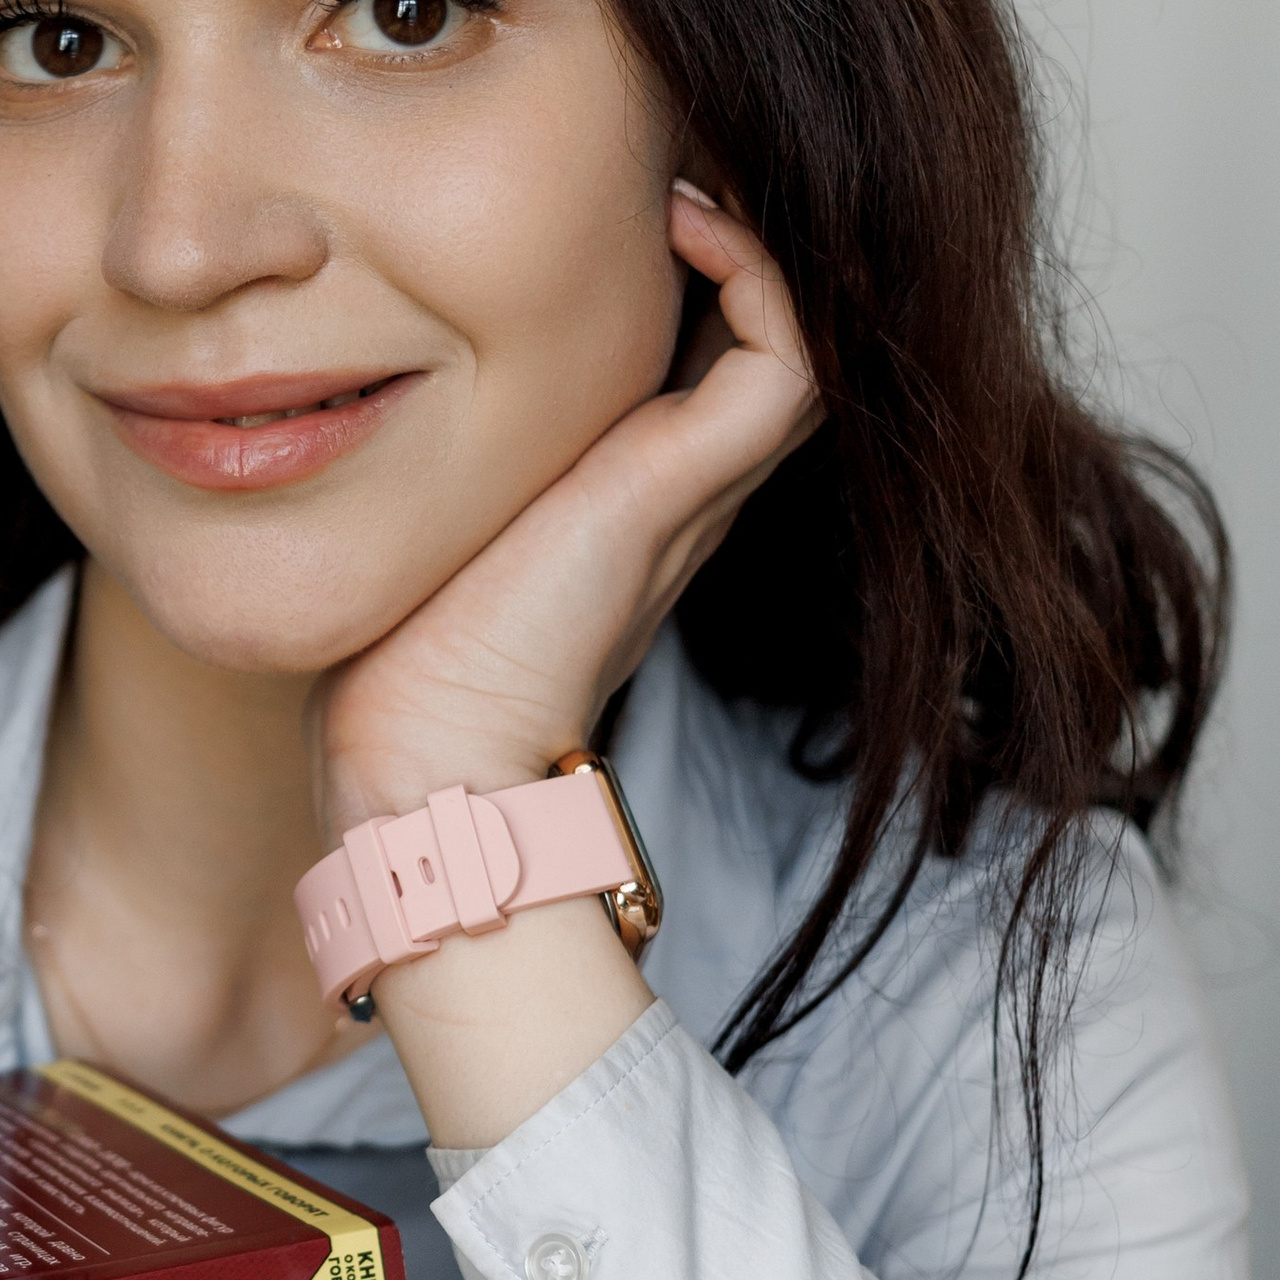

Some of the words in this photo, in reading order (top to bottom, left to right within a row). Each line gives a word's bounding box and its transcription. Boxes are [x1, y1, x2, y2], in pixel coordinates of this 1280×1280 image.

[11, 1212, 56, 1238] которой
[47, 1240, 86, 1261] давно
[200, 1216, 235, 1234] фигур
[7, 1231, 61, 1265] страницах
[344, 1254, 353, 1263] О
